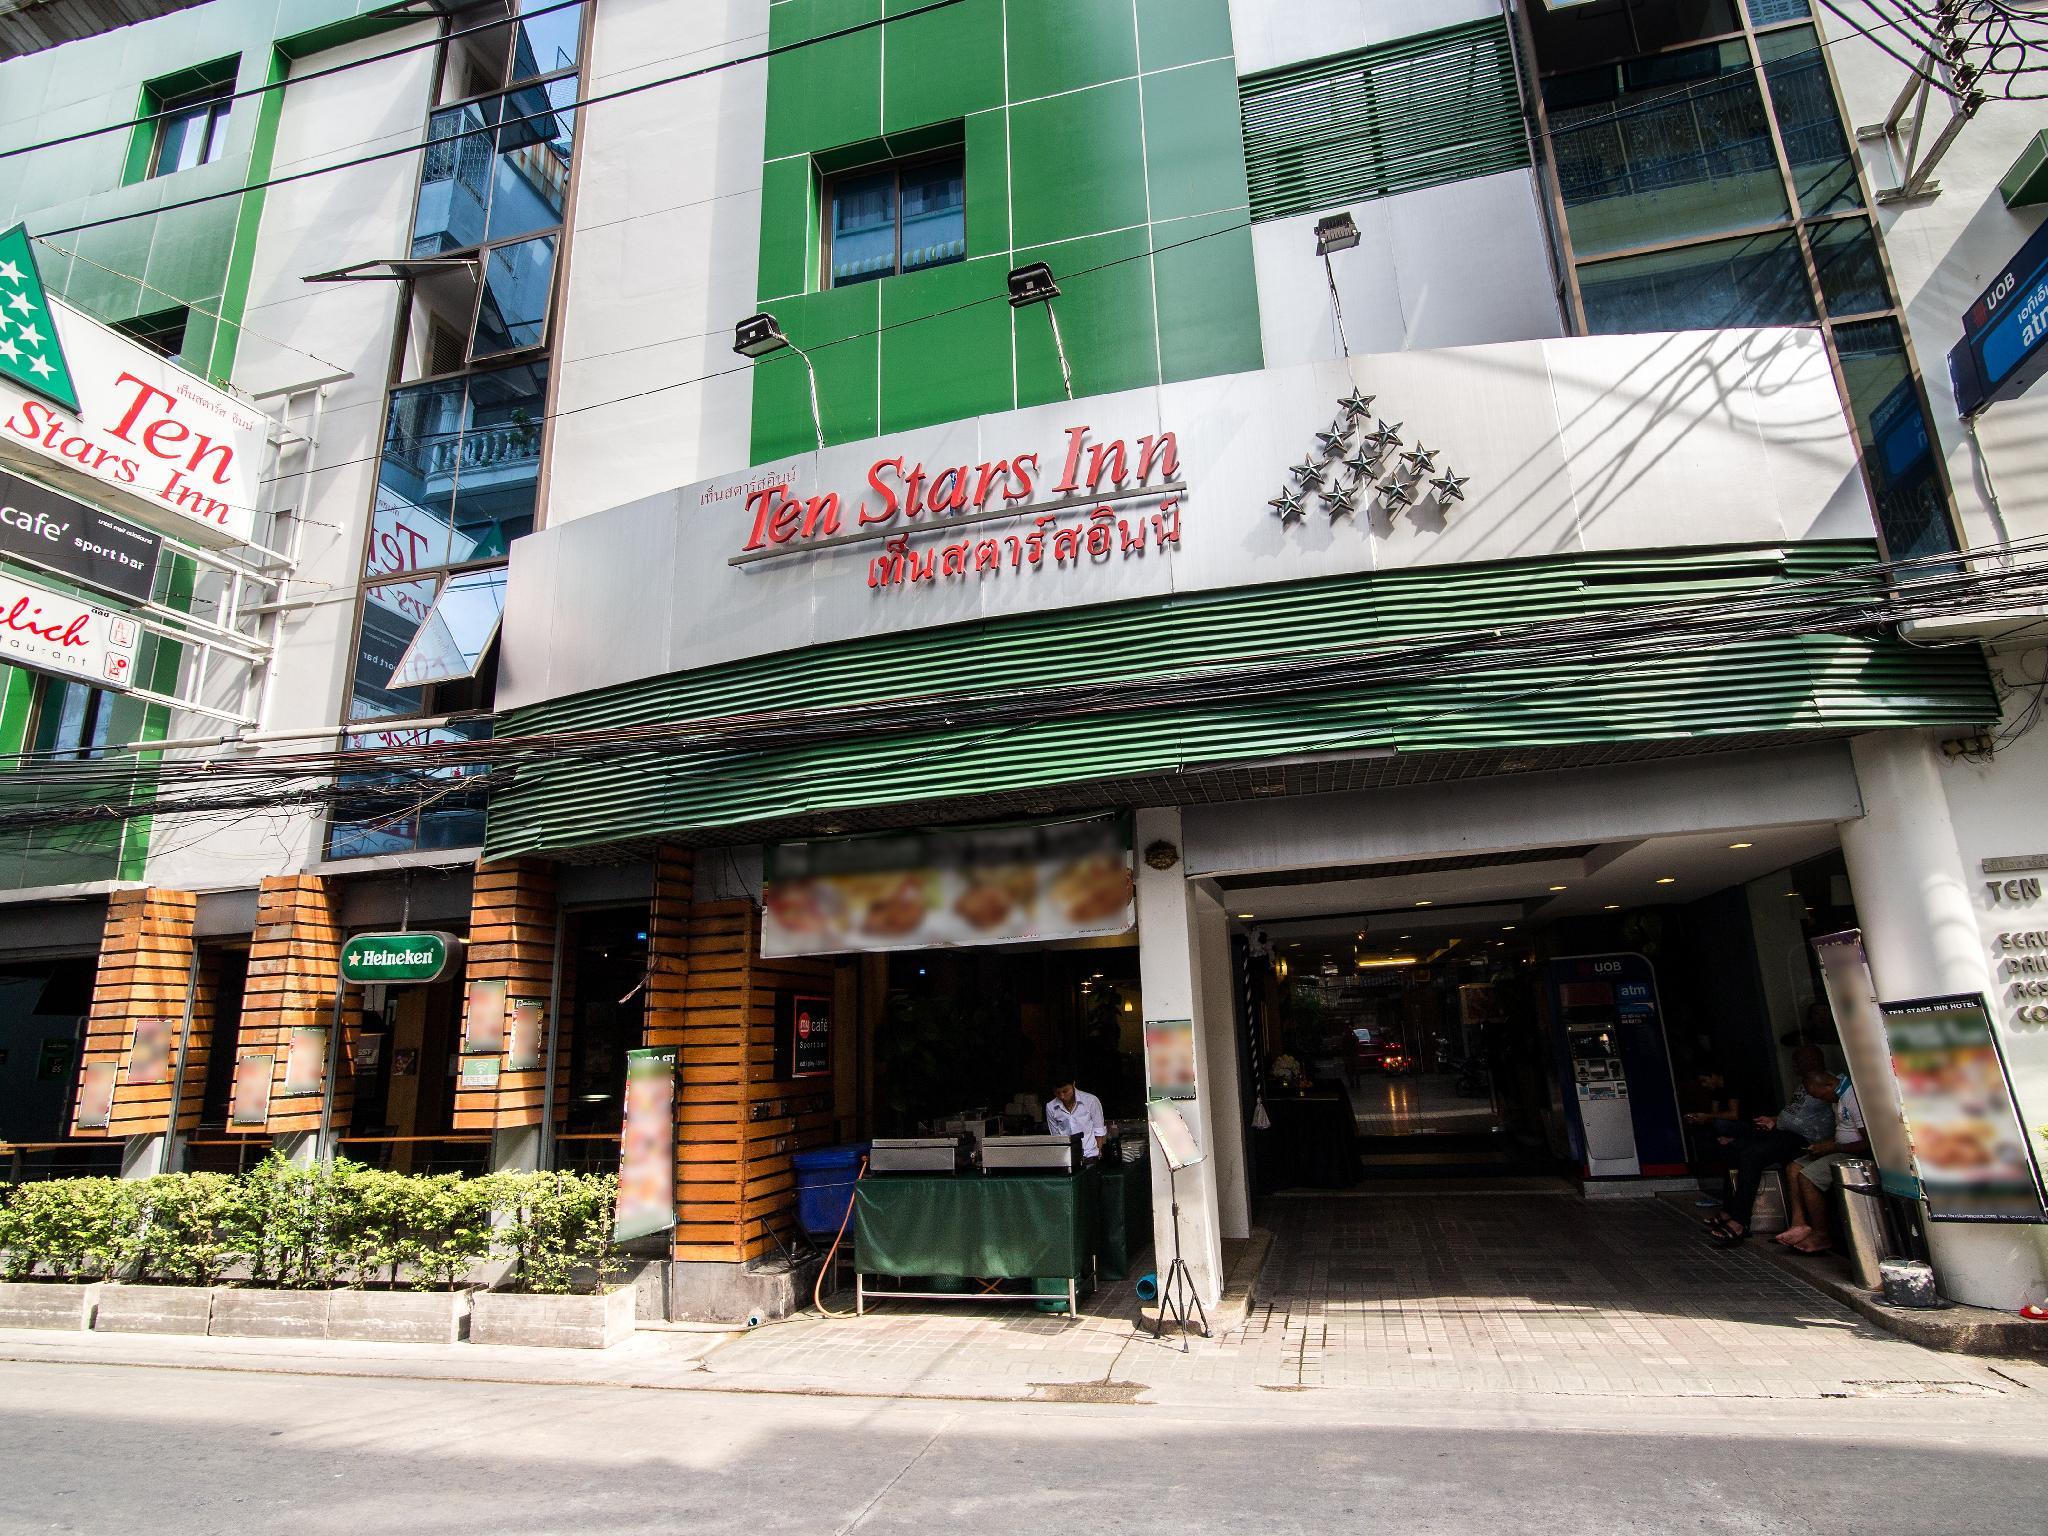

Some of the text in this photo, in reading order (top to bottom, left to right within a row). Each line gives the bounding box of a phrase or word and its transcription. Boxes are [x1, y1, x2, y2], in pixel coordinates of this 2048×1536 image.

[1986, 272, 2015, 311] UOB
[103, 371, 234, 484] Ten
[5, 400, 230, 524] Stars Inn
[742, 425, 1180, 552] Ten Stars Inn
[74, 536, 116, 561] sport
[119, 552, 145, 571] bar
[867, 496, 1181, 590] เท็นสตาร์สอินน์
[0, 597, 89, 646] lich
[1986, 878, 2042, 903] TEN
[362, 948, 434, 966] Heineken
[1594, 961, 1622, 972] UOB
[1621, 985, 1646, 996] atm
[1906, 1006, 1932, 1015] STARS
[1950, 1001, 1978, 1010] HOTEL
